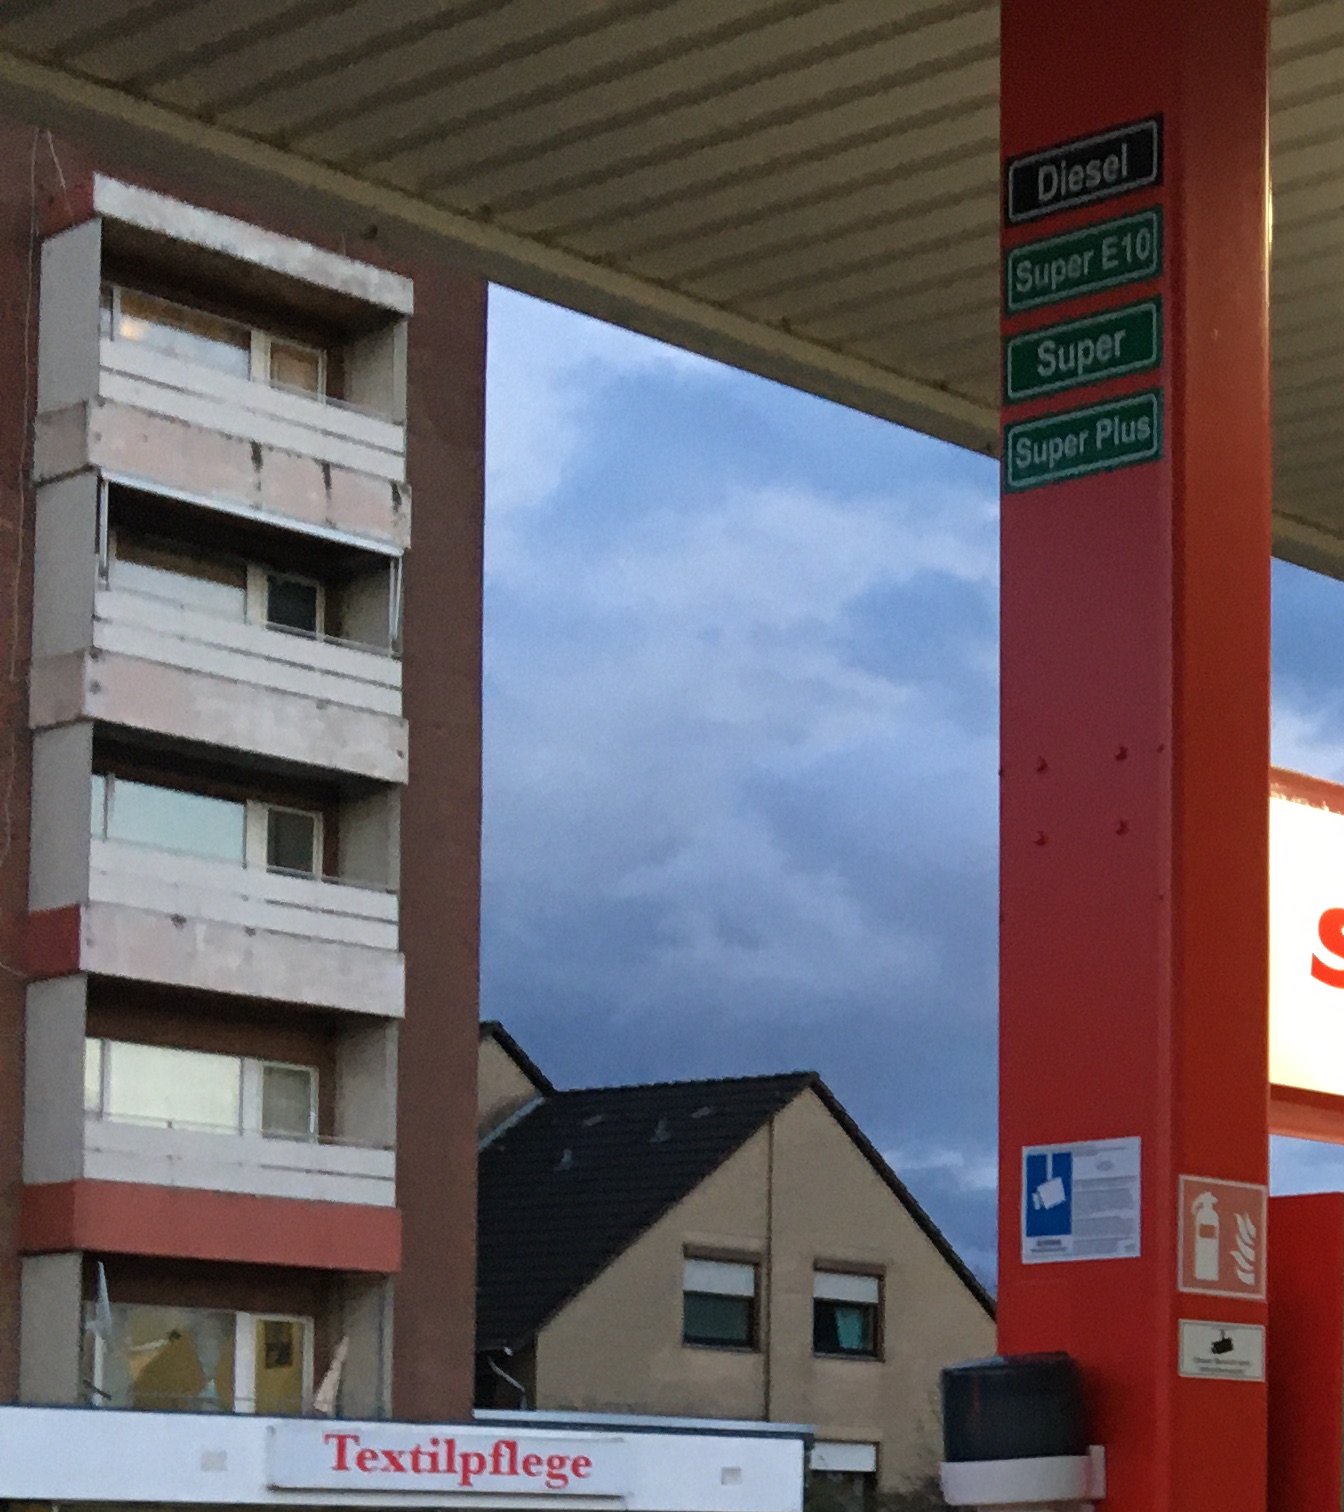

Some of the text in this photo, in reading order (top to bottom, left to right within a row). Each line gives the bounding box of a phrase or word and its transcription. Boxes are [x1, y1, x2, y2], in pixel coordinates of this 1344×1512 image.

[1037, 142, 1128, 201] Diesel
[1015, 226, 1152, 295] Super E10
[1036, 327, 1128, 378] Super
[1015, 414, 1152, 470] Super Plus
[324, 1434, 592, 1489] Textilpflege
